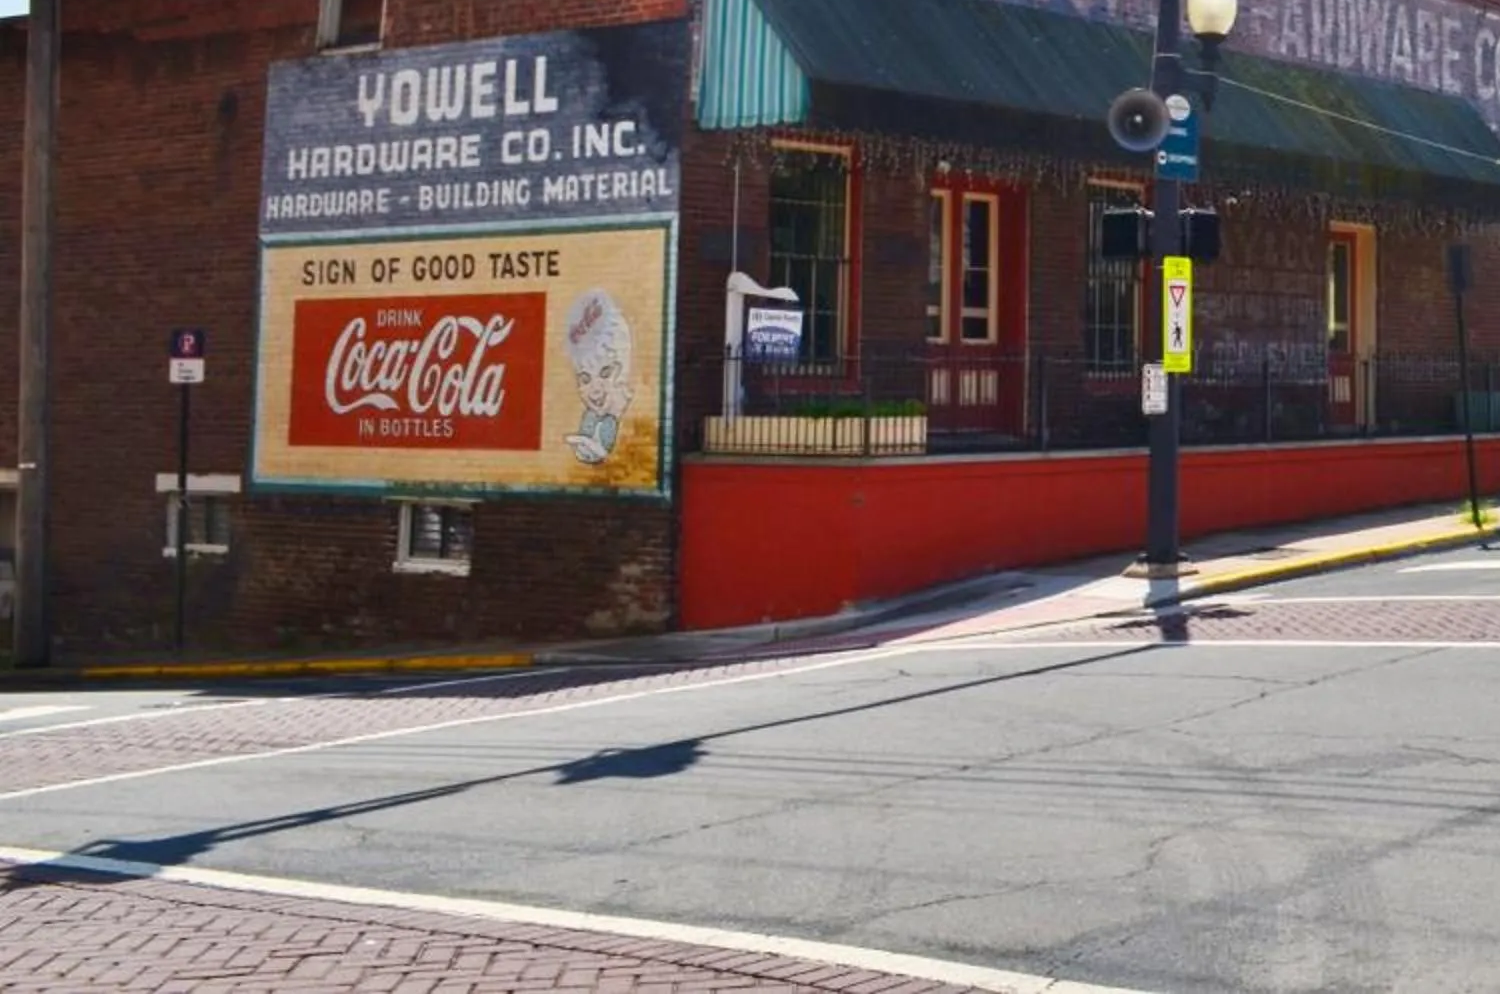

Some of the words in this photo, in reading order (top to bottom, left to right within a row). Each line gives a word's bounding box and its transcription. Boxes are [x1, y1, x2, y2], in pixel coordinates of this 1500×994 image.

[356, 56, 558, 127] YOWELL
[288, 136, 481, 180] HARDWARE
[501, 129, 562, 164] CO.
[573, 121, 645, 159] INC.
[266, 189, 391, 219] HARDWARE
[419, 180, 531, 212] BUILDING
[543, 169, 673, 204] MATERIAL
[302, 259, 356, 286] SIGN
[371, 257, 401, 282] OF
[412, 254, 476, 281] GOOD
[489, 250, 561, 279] TASTE
[376, 309, 423, 329] DRINK
[325, 313, 515, 417] Coca-Cola
[358, 419, 376, 438] IN
[380, 418, 454, 439] BOTTLES
